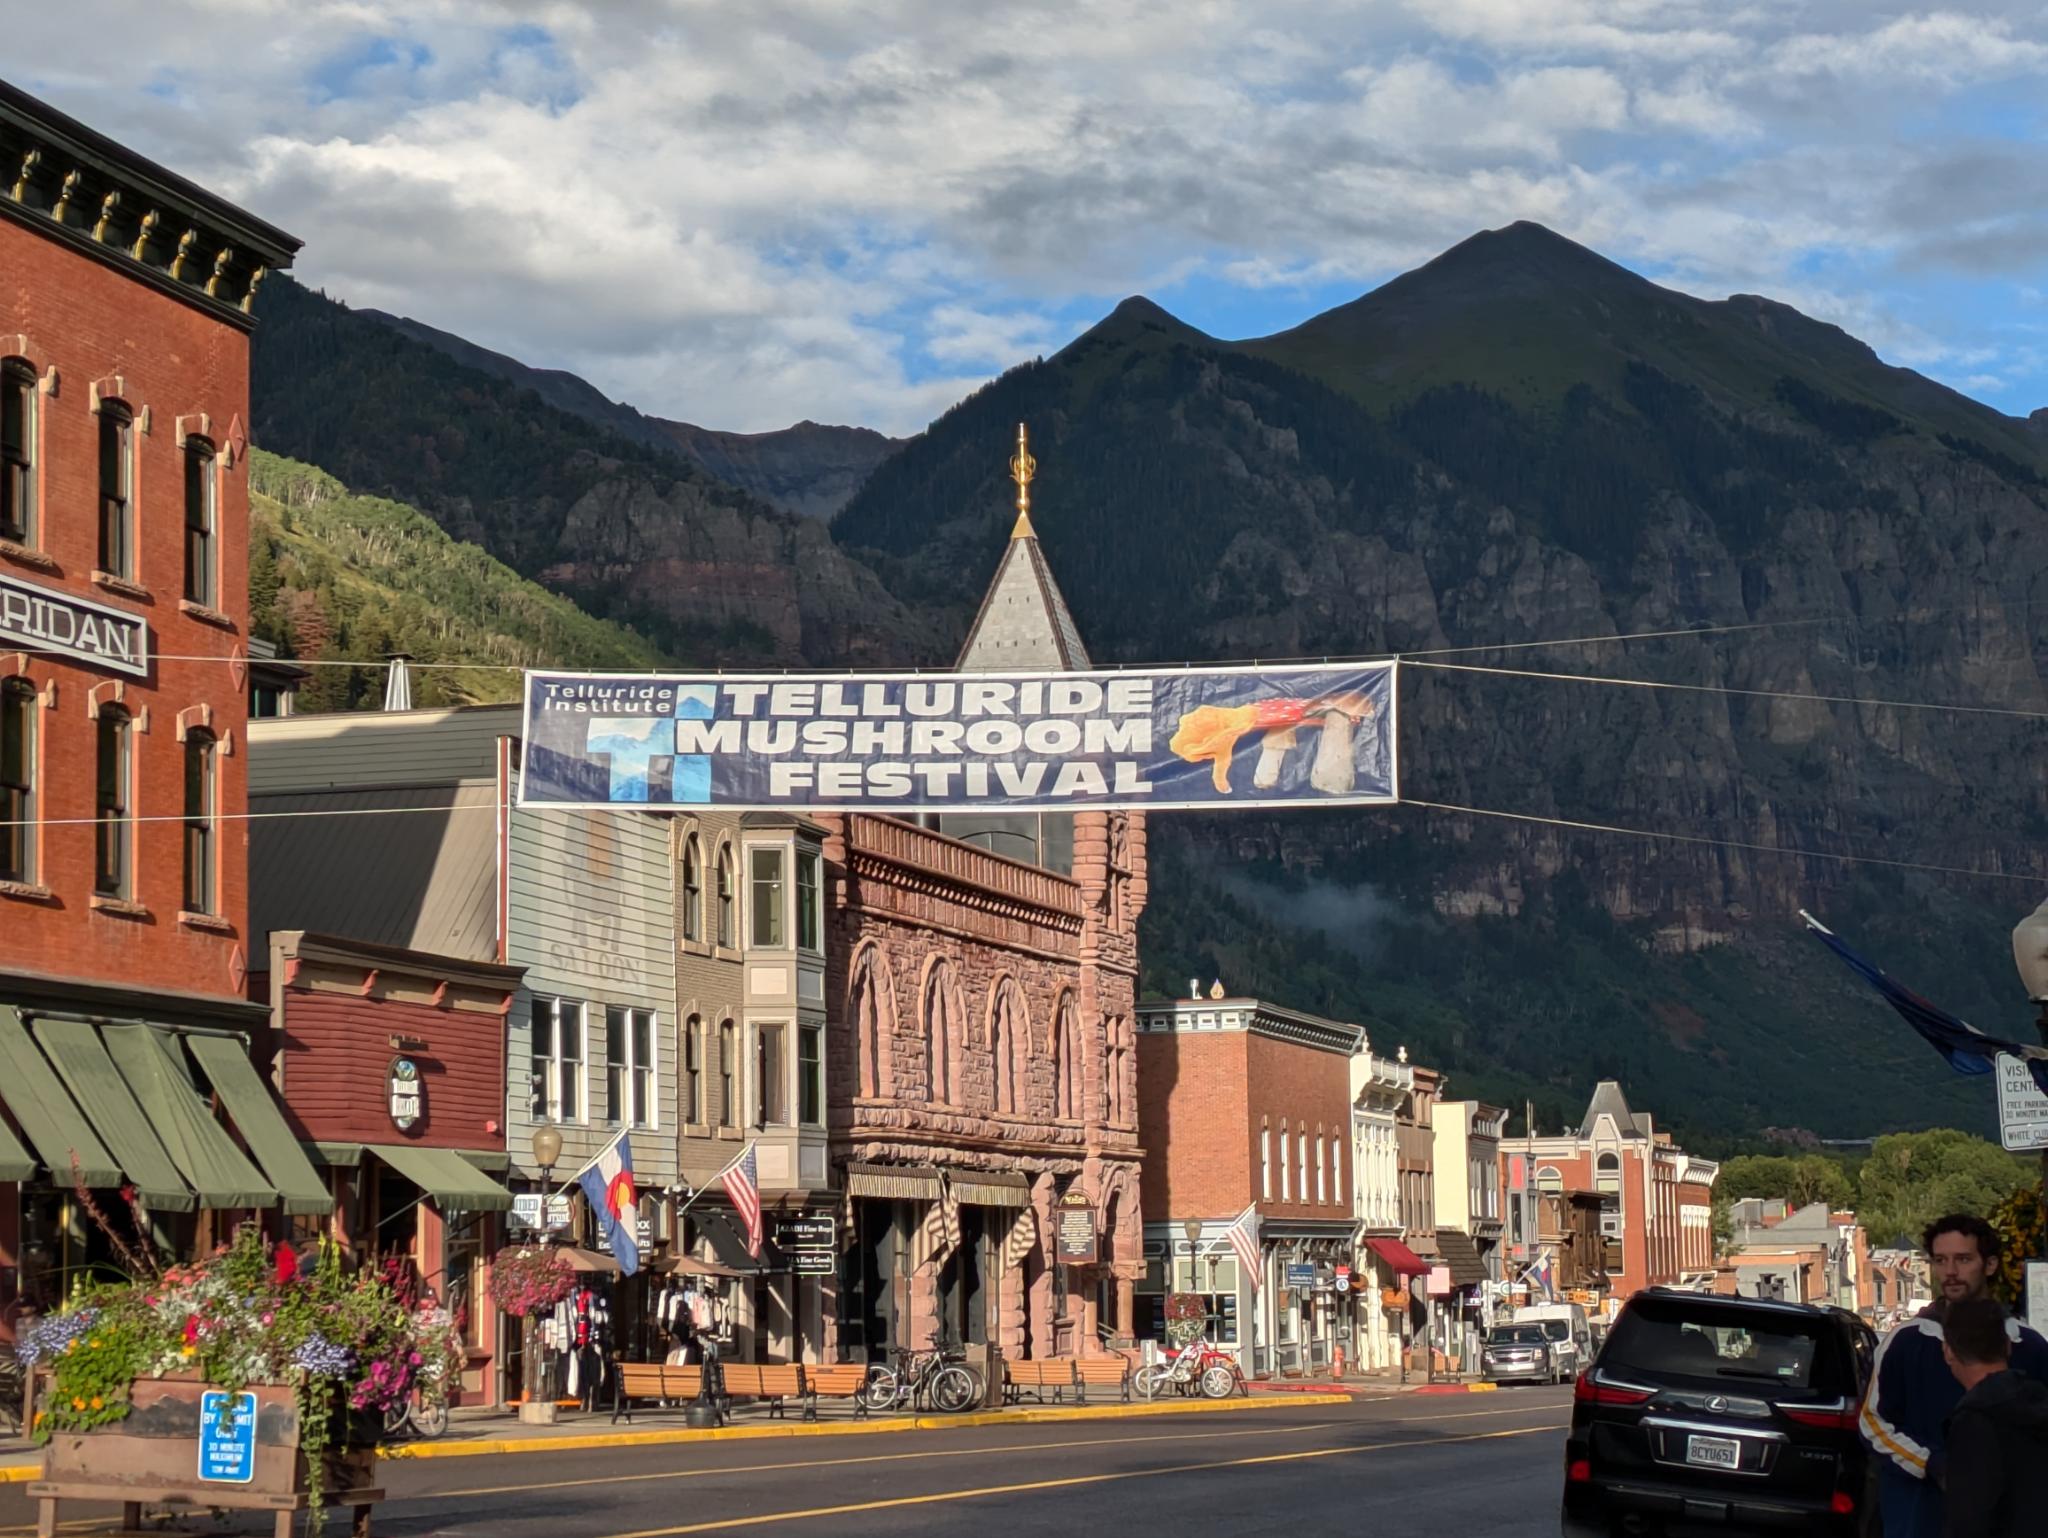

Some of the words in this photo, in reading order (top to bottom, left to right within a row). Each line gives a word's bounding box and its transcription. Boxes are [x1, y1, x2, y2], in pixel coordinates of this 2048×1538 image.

[545, 684, 673, 699] Telluride
[723, 680, 1153, 716] TELLURIDE
[544, 697, 671, 713] Institute
[676, 719, 1153, 755] MUSHROOM
[769, 761, 1153, 797] FESTIVAL
[550, 942, 640, 983] SALOON
[2005, 1064, 2032, 1077] VISI
[203, 1412, 216, 1424] BY
[1691, 1445, 1733, 1462] 8CYU651
